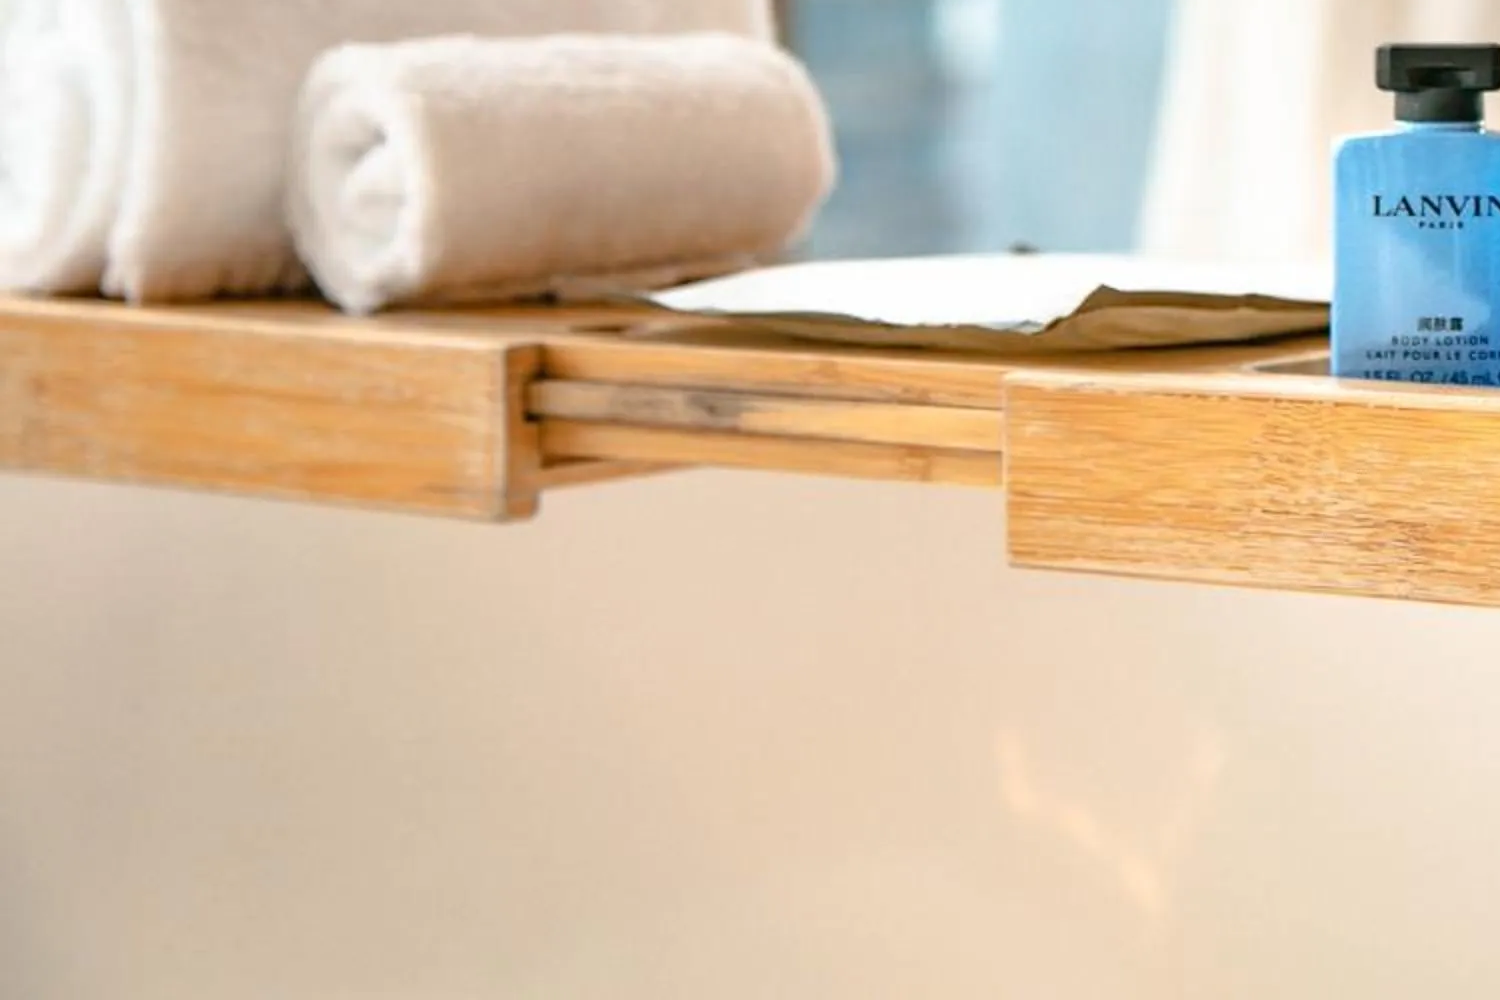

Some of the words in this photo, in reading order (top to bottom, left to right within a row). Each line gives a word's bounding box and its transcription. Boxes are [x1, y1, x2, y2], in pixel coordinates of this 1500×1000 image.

[1418, 221, 1465, 230] PARIS
[1391, 335, 1429, 347] BODY
[1435, 335, 1490, 347] LOTION
[1365, 350, 1396, 361] LAIT
[1402, 350, 1441, 361] POUR
[1446, 350, 1461, 361] LE
